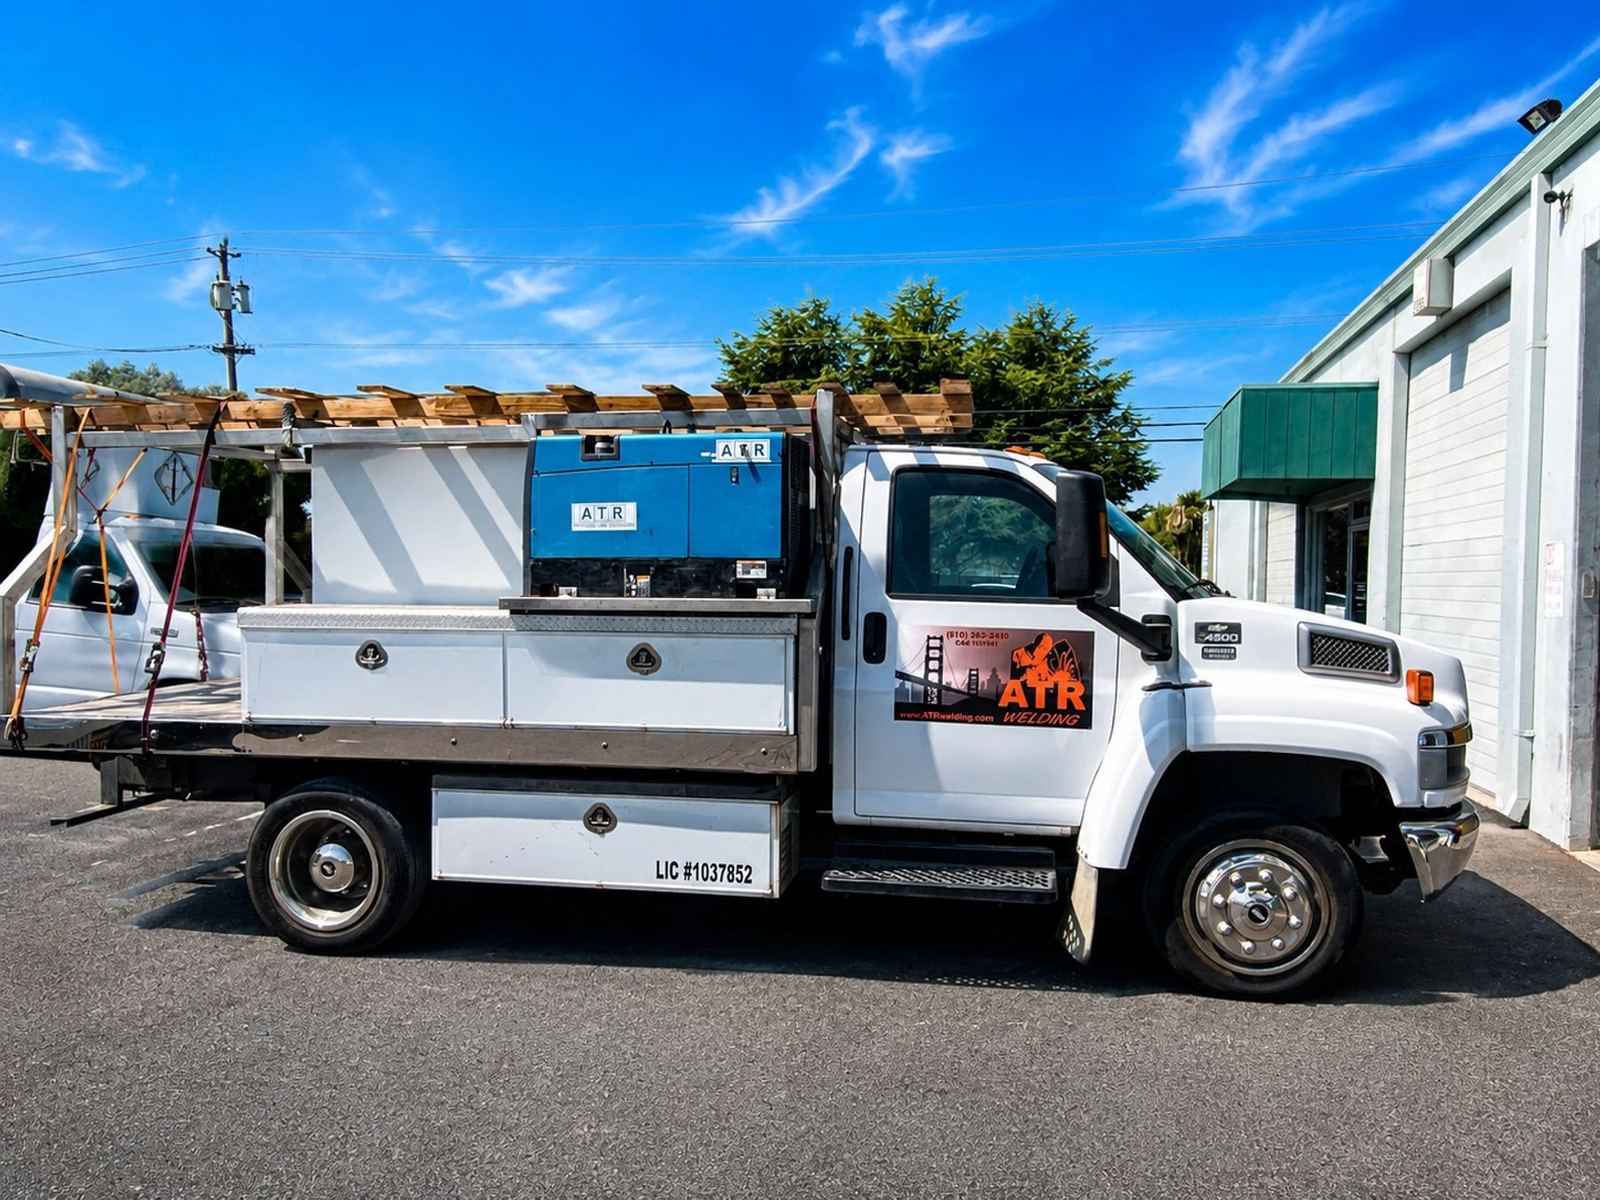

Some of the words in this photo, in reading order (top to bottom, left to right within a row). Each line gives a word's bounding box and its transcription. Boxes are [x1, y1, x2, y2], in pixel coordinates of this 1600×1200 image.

[721, 443, 765, 457] ATR
[581, 506, 623, 520] ATR
[998, 679, 1086, 710] ATR
[900, 711, 995, 723] www.ATRwelding.com
[1003, 712, 1081, 726] WELDING
[656, 860, 679, 880] LIC
[683, 861, 753, 884] #1037852
